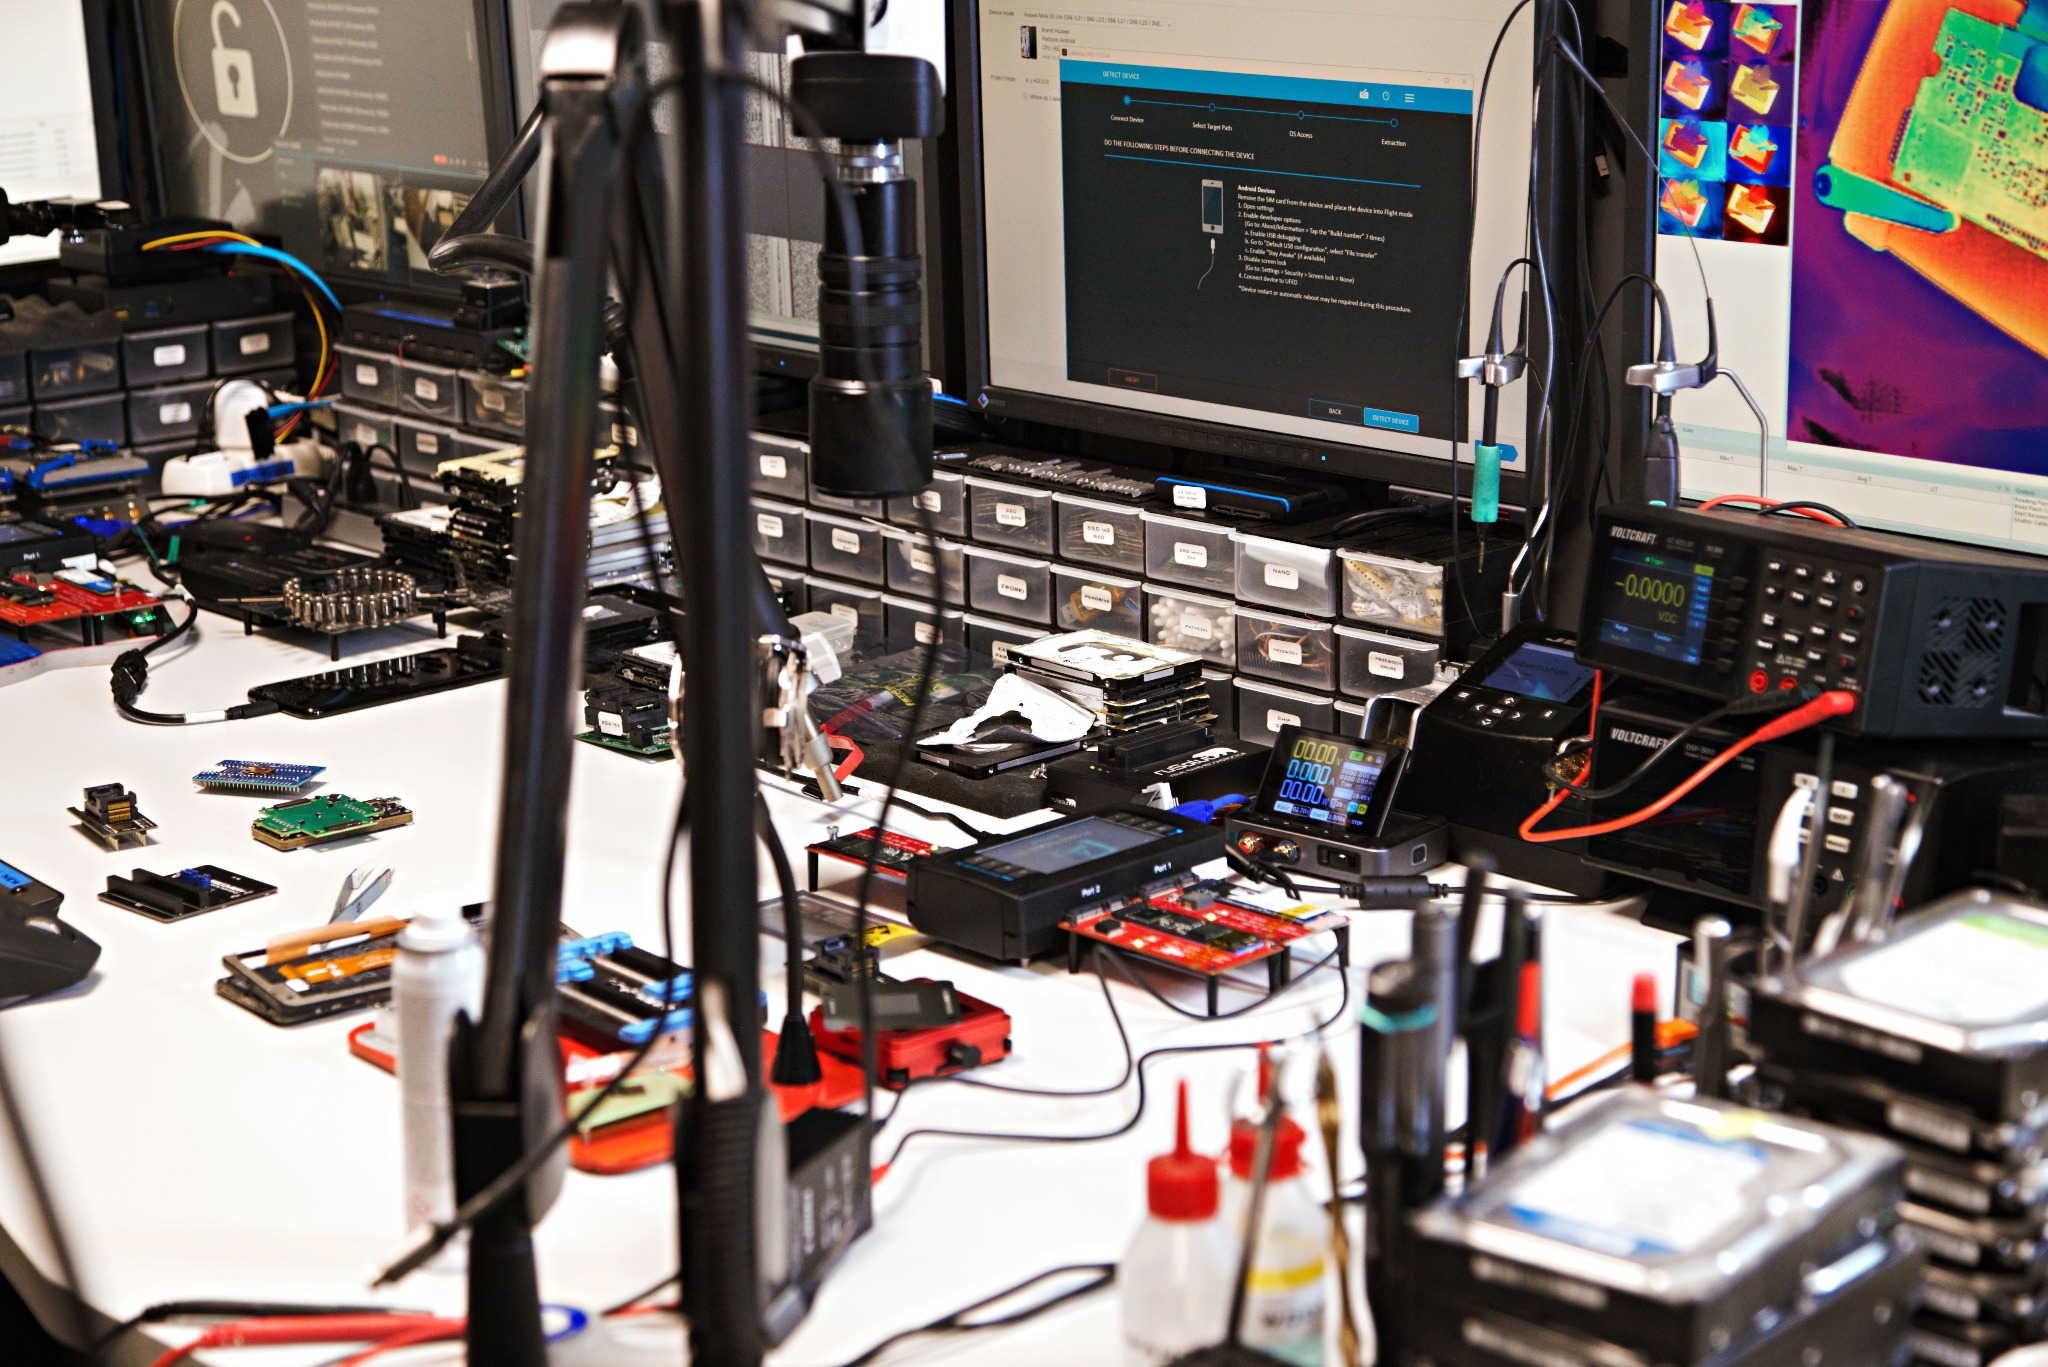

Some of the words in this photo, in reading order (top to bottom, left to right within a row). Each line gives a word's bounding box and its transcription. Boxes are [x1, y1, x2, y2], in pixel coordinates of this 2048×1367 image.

[1124, 141, 1153, 150] FOLLOWING
[1170, 145, 1189, 154] BEFORE
[1190, 147, 1224, 157] CONNECTING
[1260, 214, 1282, 222] developer
[1384, 209, 1398, 217] Flight
[1262, 223, 1304, 232] About/Information
[1277, 234, 1301, 242] debugging
[1262, 266, 1280, 275] Settings
[1285, 270, 1304, 278] Security
[1339, 276, 1355, 284] None)
[1359, 301, 1374, 309] during
[1610, 526, 1657, 545] VOLTCRAFT
[1001, 584, 1025, 593] ZWORKI
[1616, 574, 1685, 607] -0.0000
[1660, 611, 1678, 624] VDC
[1615, 624, 1629, 632] Range
[1611, 728, 1670, 749] VOLTCRAFT
[1293, 740, 1338, 764] 00.00
[1287, 759, 1332, 784] 0.000
[1280, 779, 1324, 804] 00.00
[1154, 864, 1167, 874] Port
[1081, 887, 1095, 897] Port
